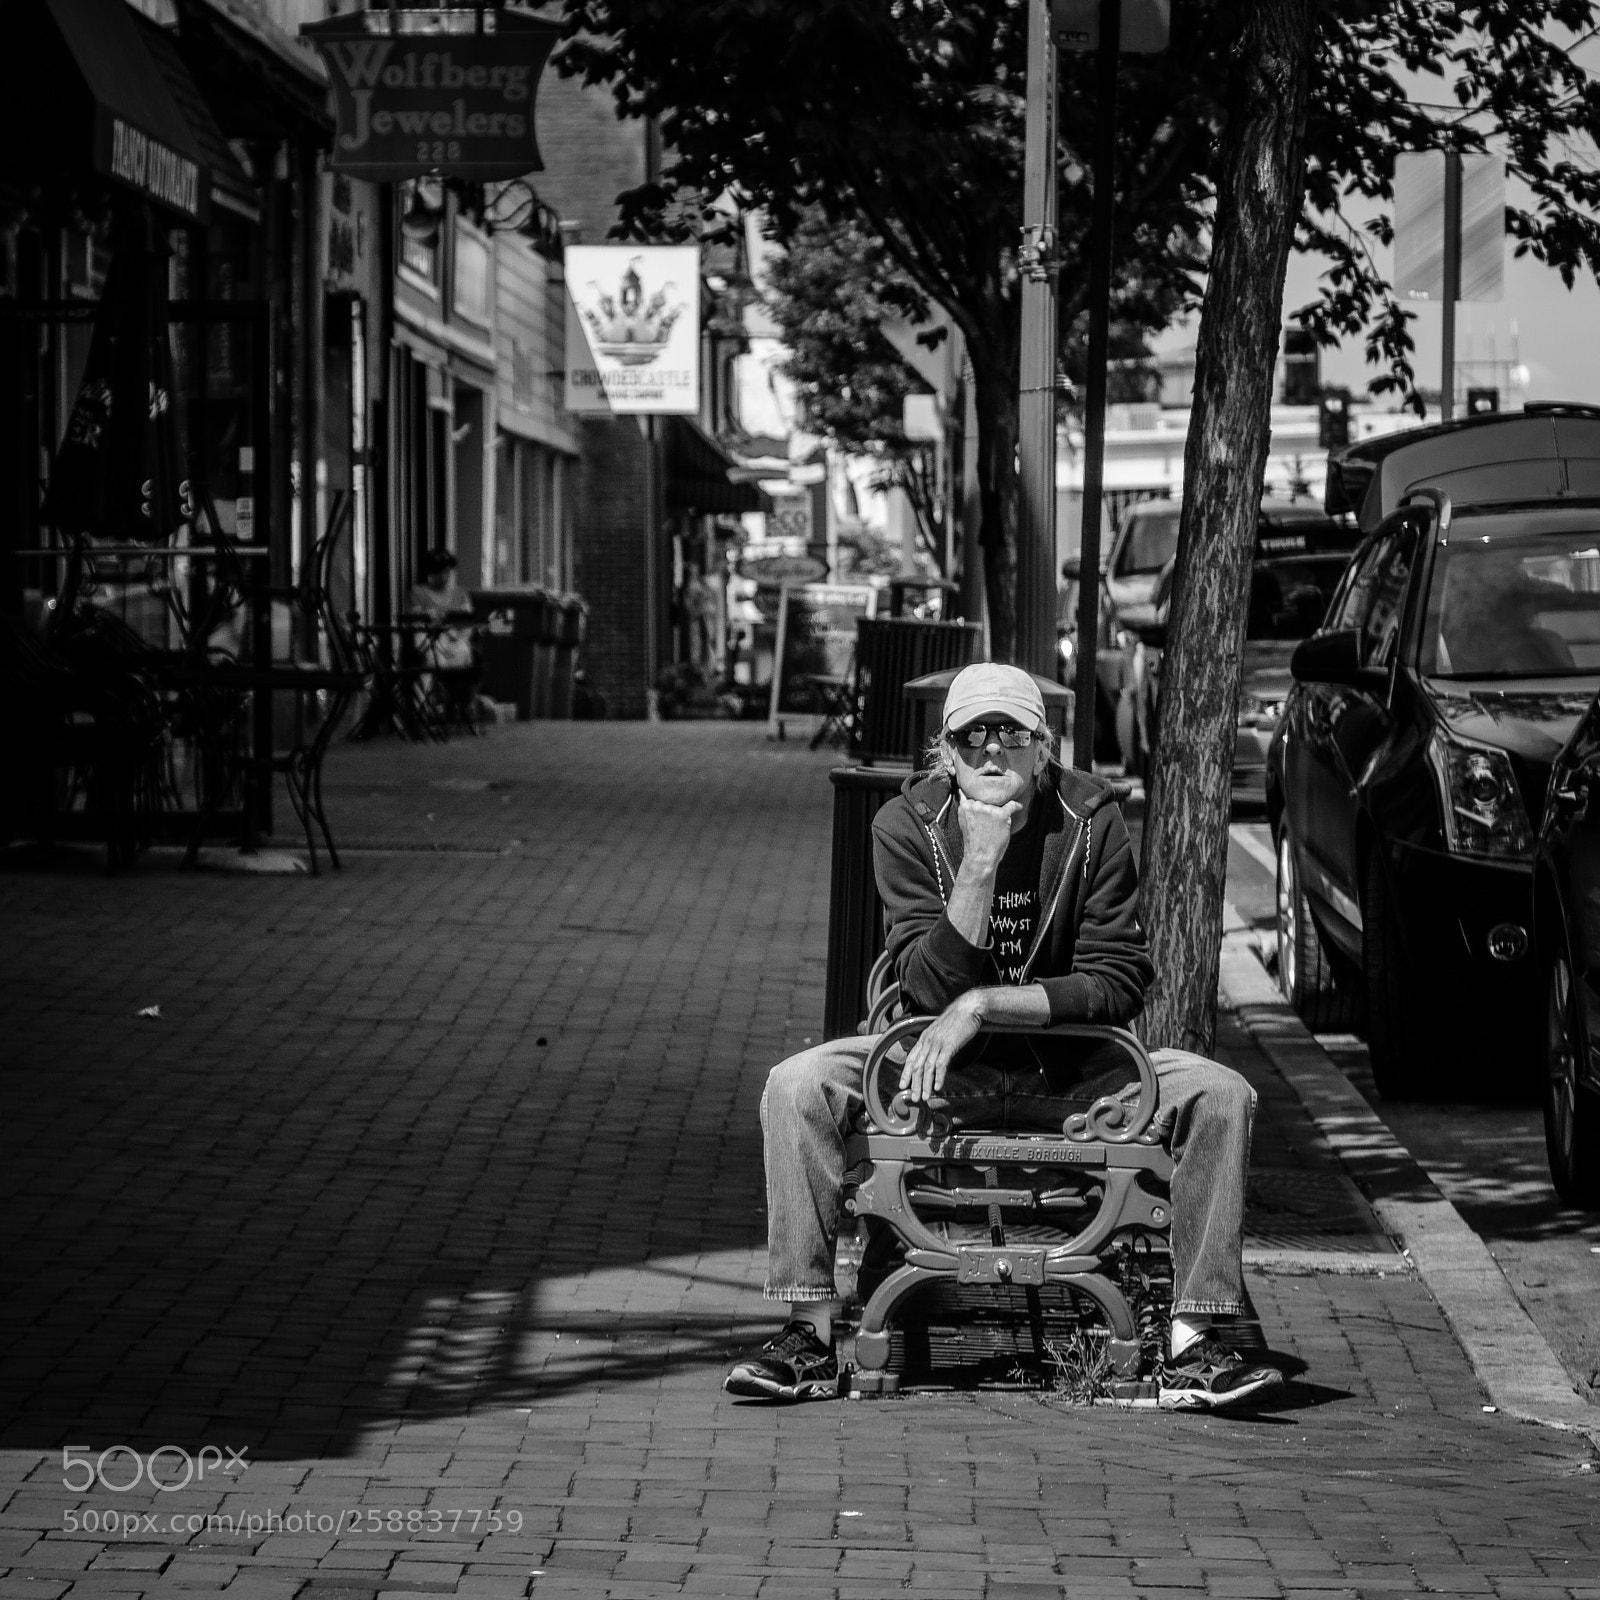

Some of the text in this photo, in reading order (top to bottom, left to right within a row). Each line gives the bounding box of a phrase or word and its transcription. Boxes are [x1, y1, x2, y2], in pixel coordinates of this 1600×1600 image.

[324, 40, 531, 101] Wolfberg
[339, 89, 526, 150] Jewelers
[998, 890, 1031, 910] THINK
[1000, 938, 1022, 956] I'M
[1027, 1149, 1082, 1162] BOROUGH
